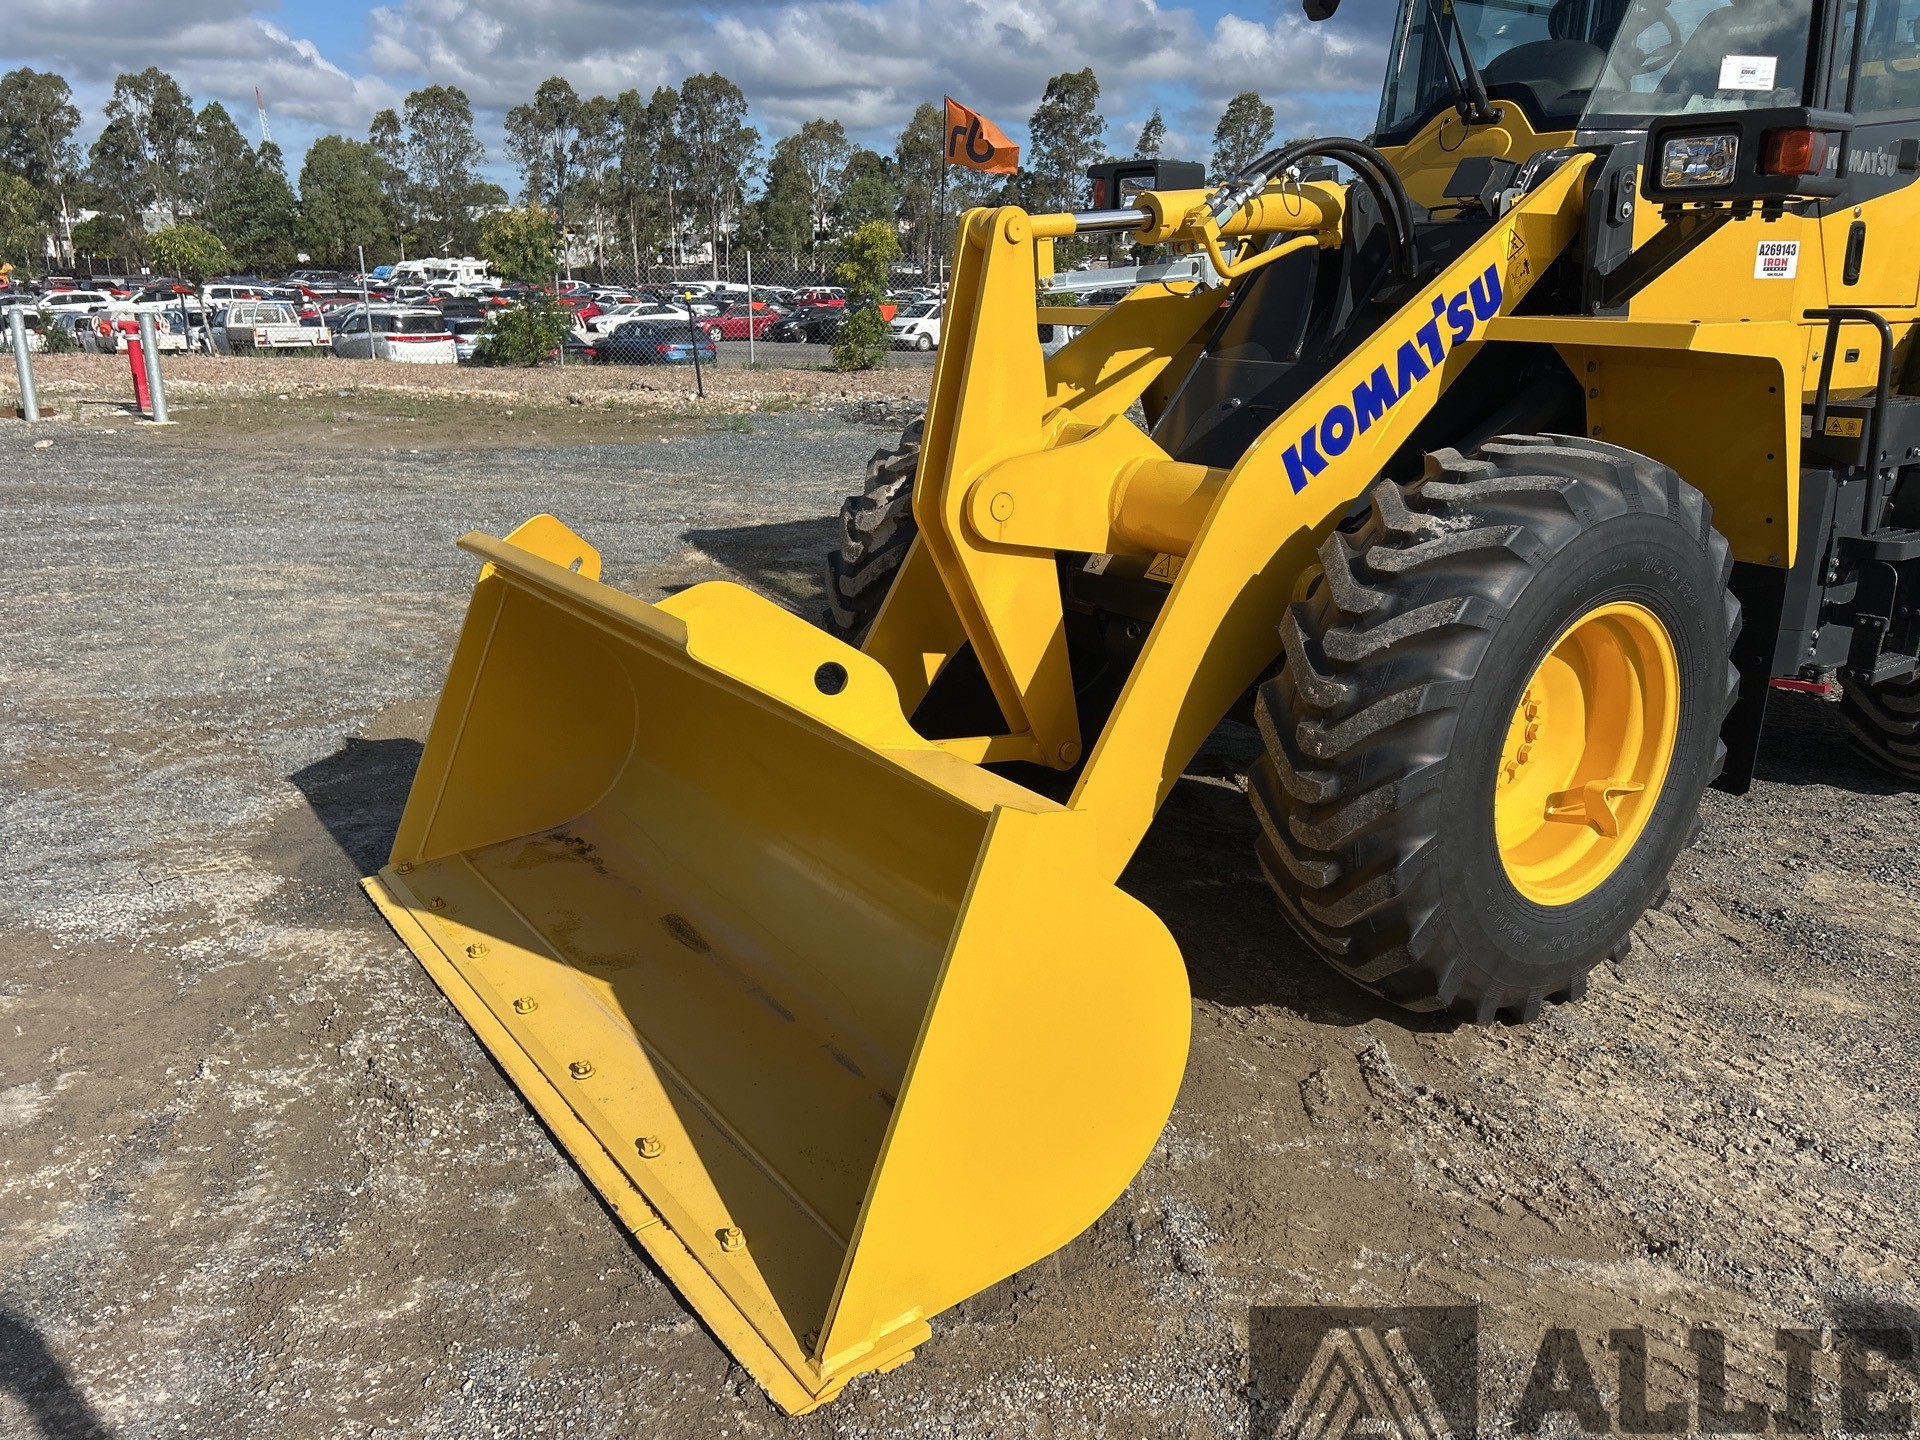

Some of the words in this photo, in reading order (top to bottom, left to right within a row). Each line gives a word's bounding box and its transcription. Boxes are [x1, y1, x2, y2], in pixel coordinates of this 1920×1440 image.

[1826, 146, 1897, 177] KMATSU
[1759, 243, 1797, 256] A269143
[1763, 257, 1789, 267] IRON
[1281, 263, 1503, 495] KOMATSU
